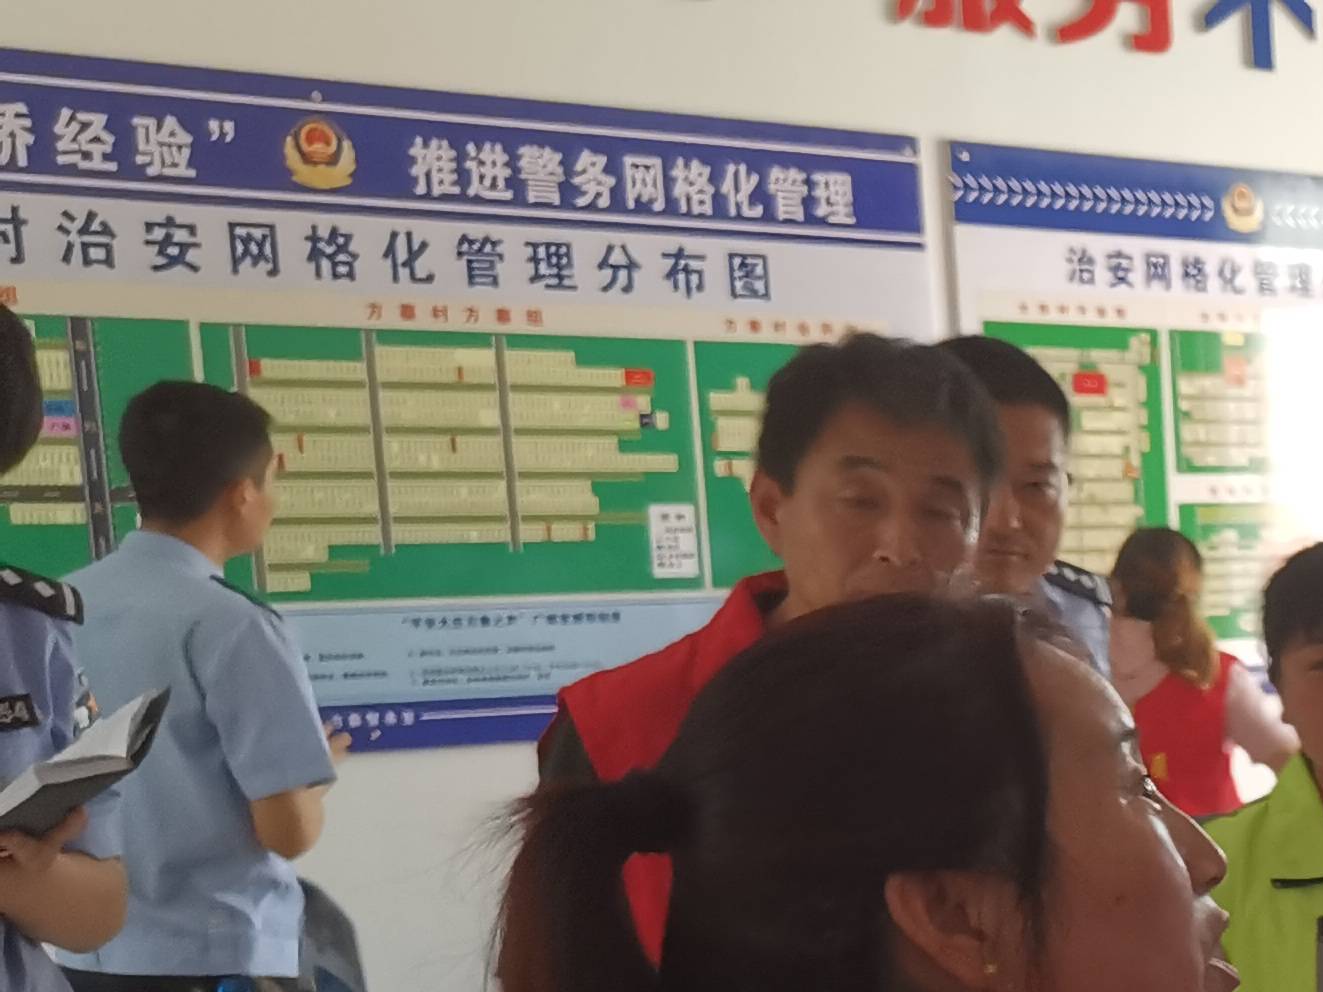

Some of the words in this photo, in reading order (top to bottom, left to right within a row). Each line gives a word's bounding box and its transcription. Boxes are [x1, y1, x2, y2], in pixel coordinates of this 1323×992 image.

[410, 136, 858, 226] 推进警务网格化管理
